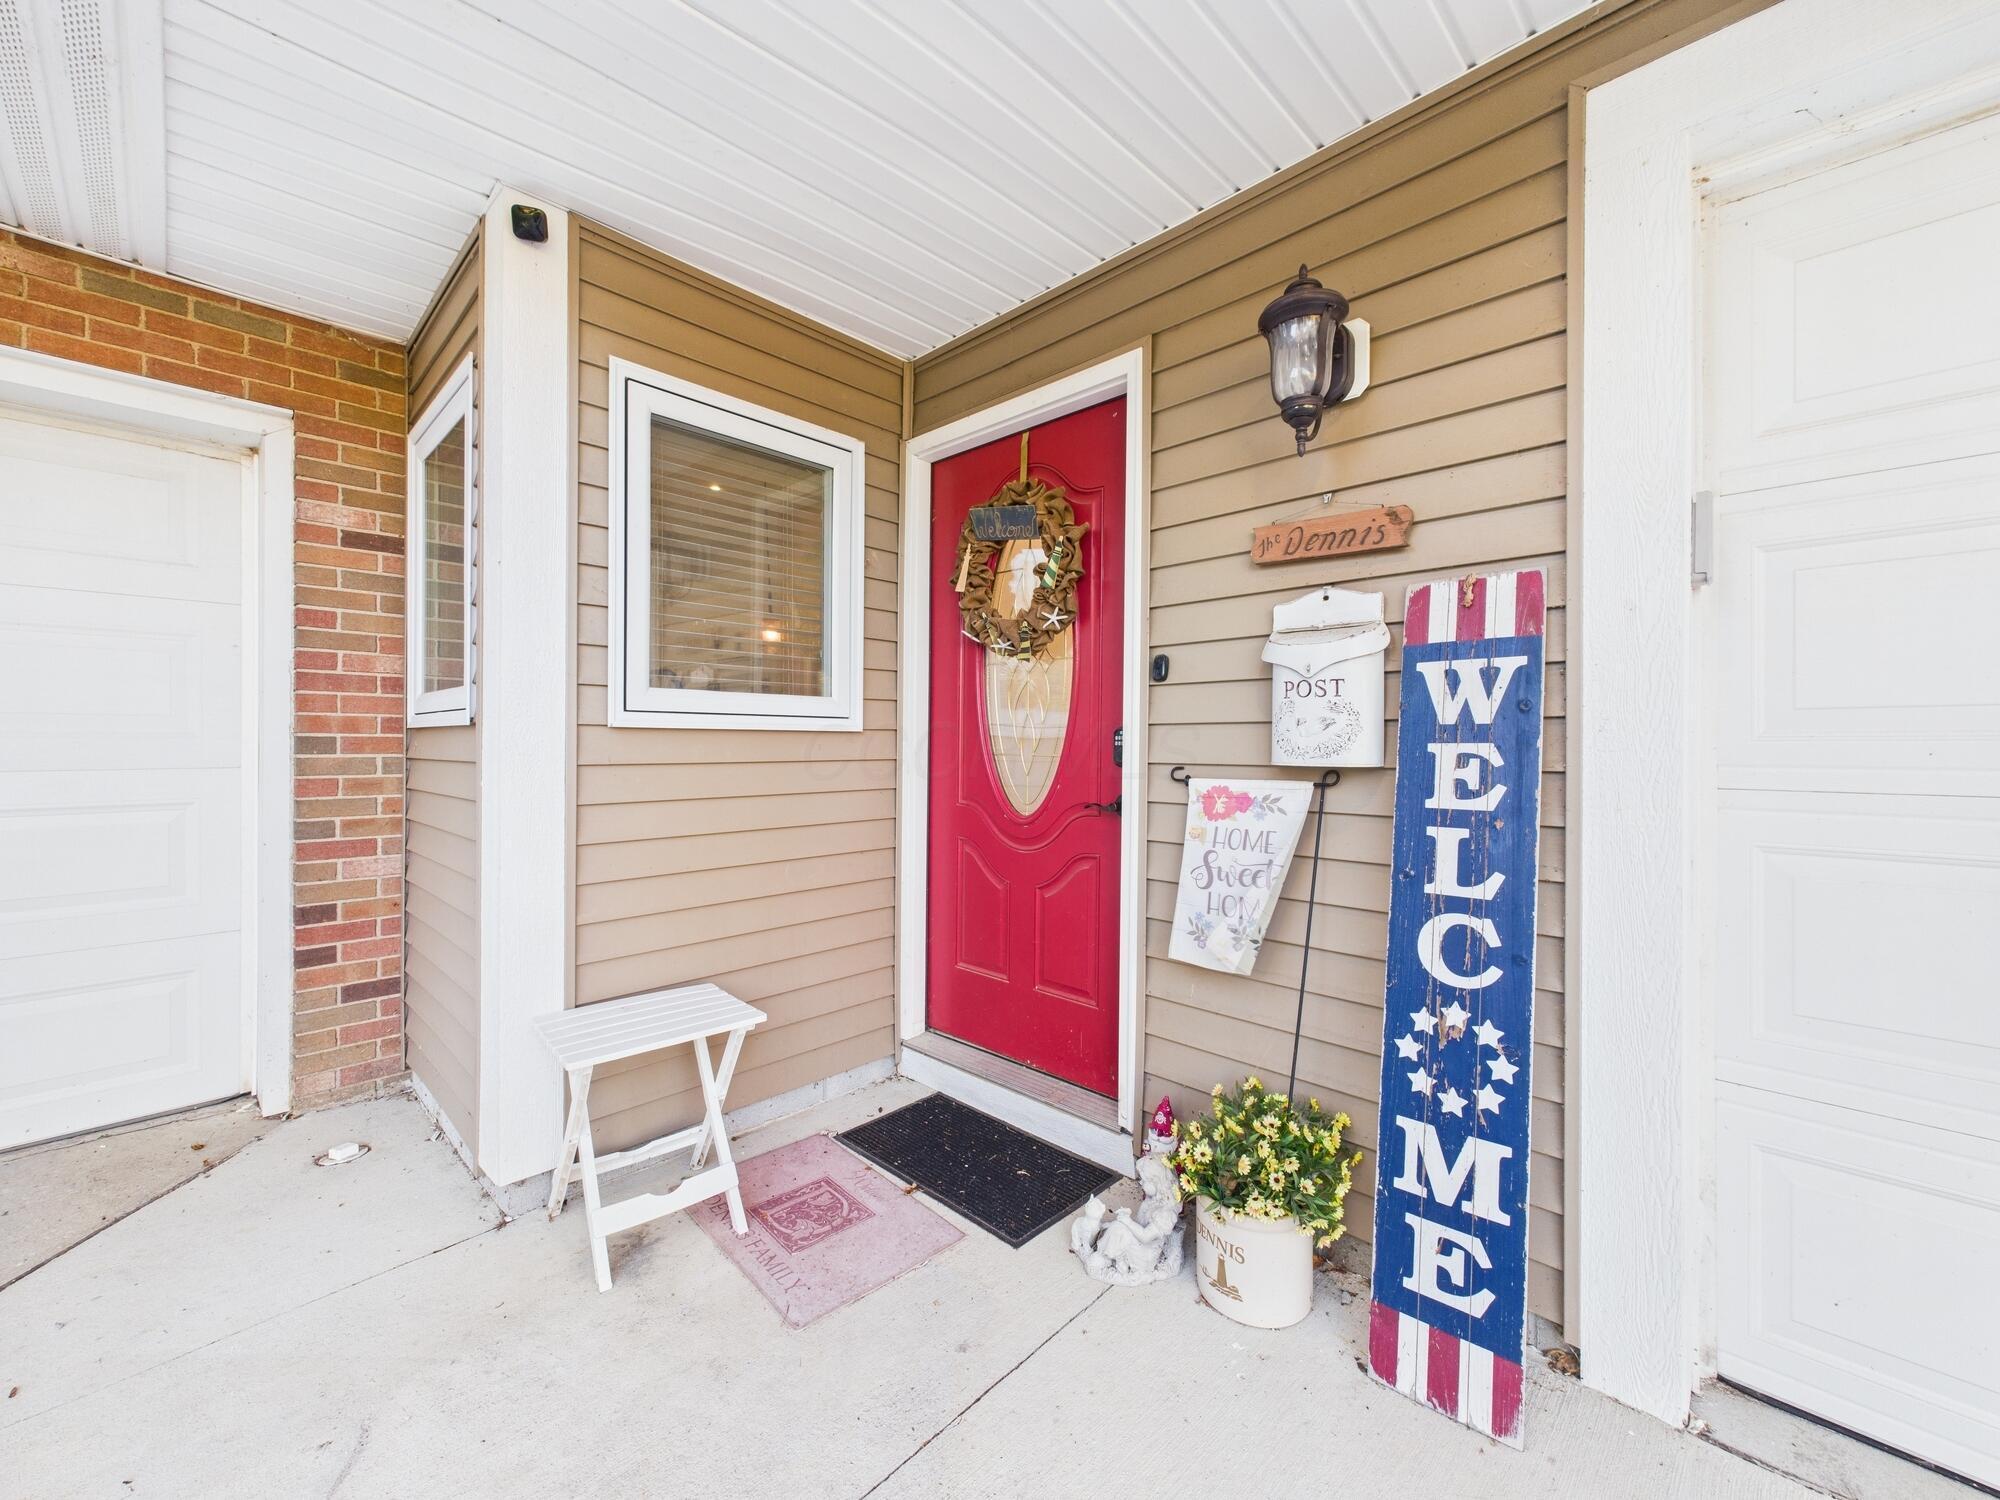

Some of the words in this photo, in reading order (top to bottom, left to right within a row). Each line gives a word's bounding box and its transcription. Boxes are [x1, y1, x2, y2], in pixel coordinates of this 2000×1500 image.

[969, 508, 1035, 538] Welcome
[1284, 525, 1386, 556] Dennis
[1283, 678, 1345, 699] POST
[1212, 826, 1277, 855] HOME
[1190, 849, 1284, 890] Sweet
[1206, 891, 1260, 920] HOM
[744, 1238, 801, 1294] FAMILY
